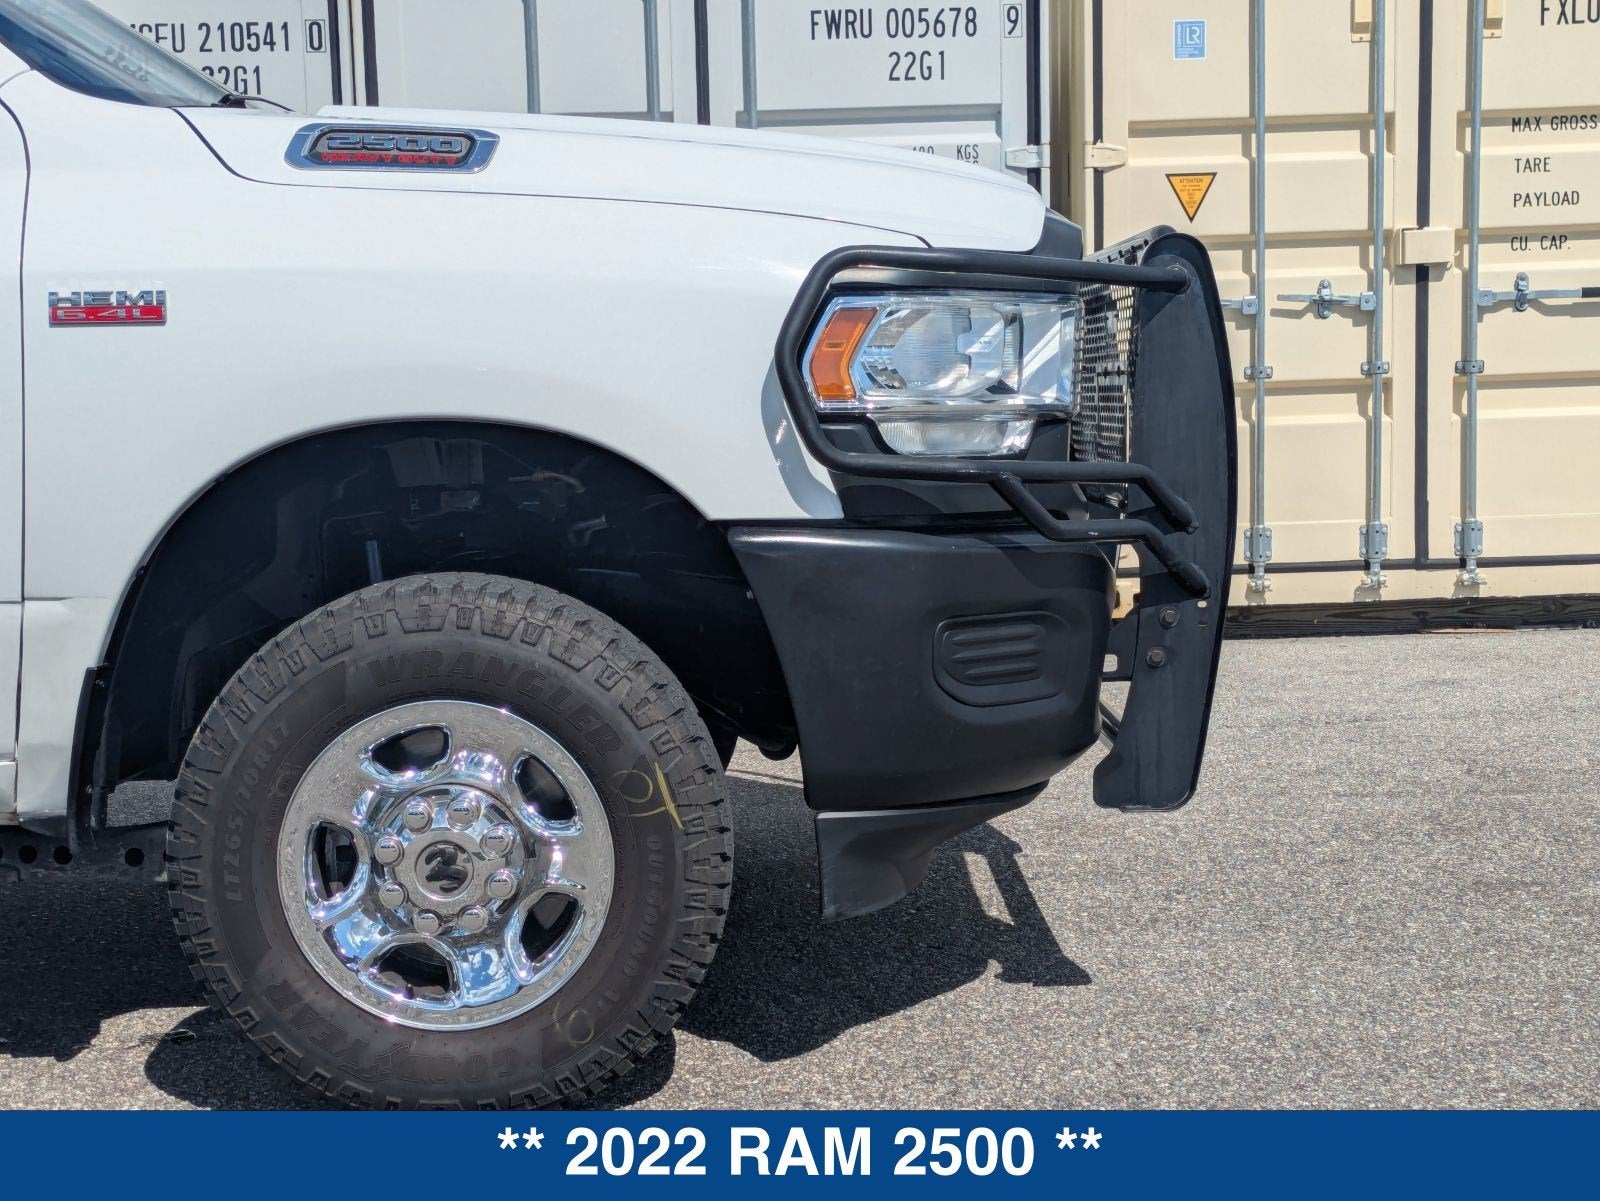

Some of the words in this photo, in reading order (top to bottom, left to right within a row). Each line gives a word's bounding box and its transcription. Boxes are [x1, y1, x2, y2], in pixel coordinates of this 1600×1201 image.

[810, 8, 873, 40] FWRU
[886, 7, 977, 39] 005678
[1006, 6, 1019, 36] 9
[198, 21, 290, 53] 210541
[888, 50, 945, 81] 22G1
[1511, 116, 1542, 132] MAX
[1551, 114, 1598, 131] GROSS
[326, 135, 463, 154] 2500
[956, 144, 979, 160] KGS
[1514, 157, 1551, 173] TARE
[1513, 191, 1580, 208] PAYLOAD
[1510, 236, 1532, 252] CU.
[1540, 235, 1571, 250] CAP.
[48, 290, 167, 307] HEMI
[56, 308, 160, 320] 6.4L
[366, 649, 625, 757] WRANGLER
